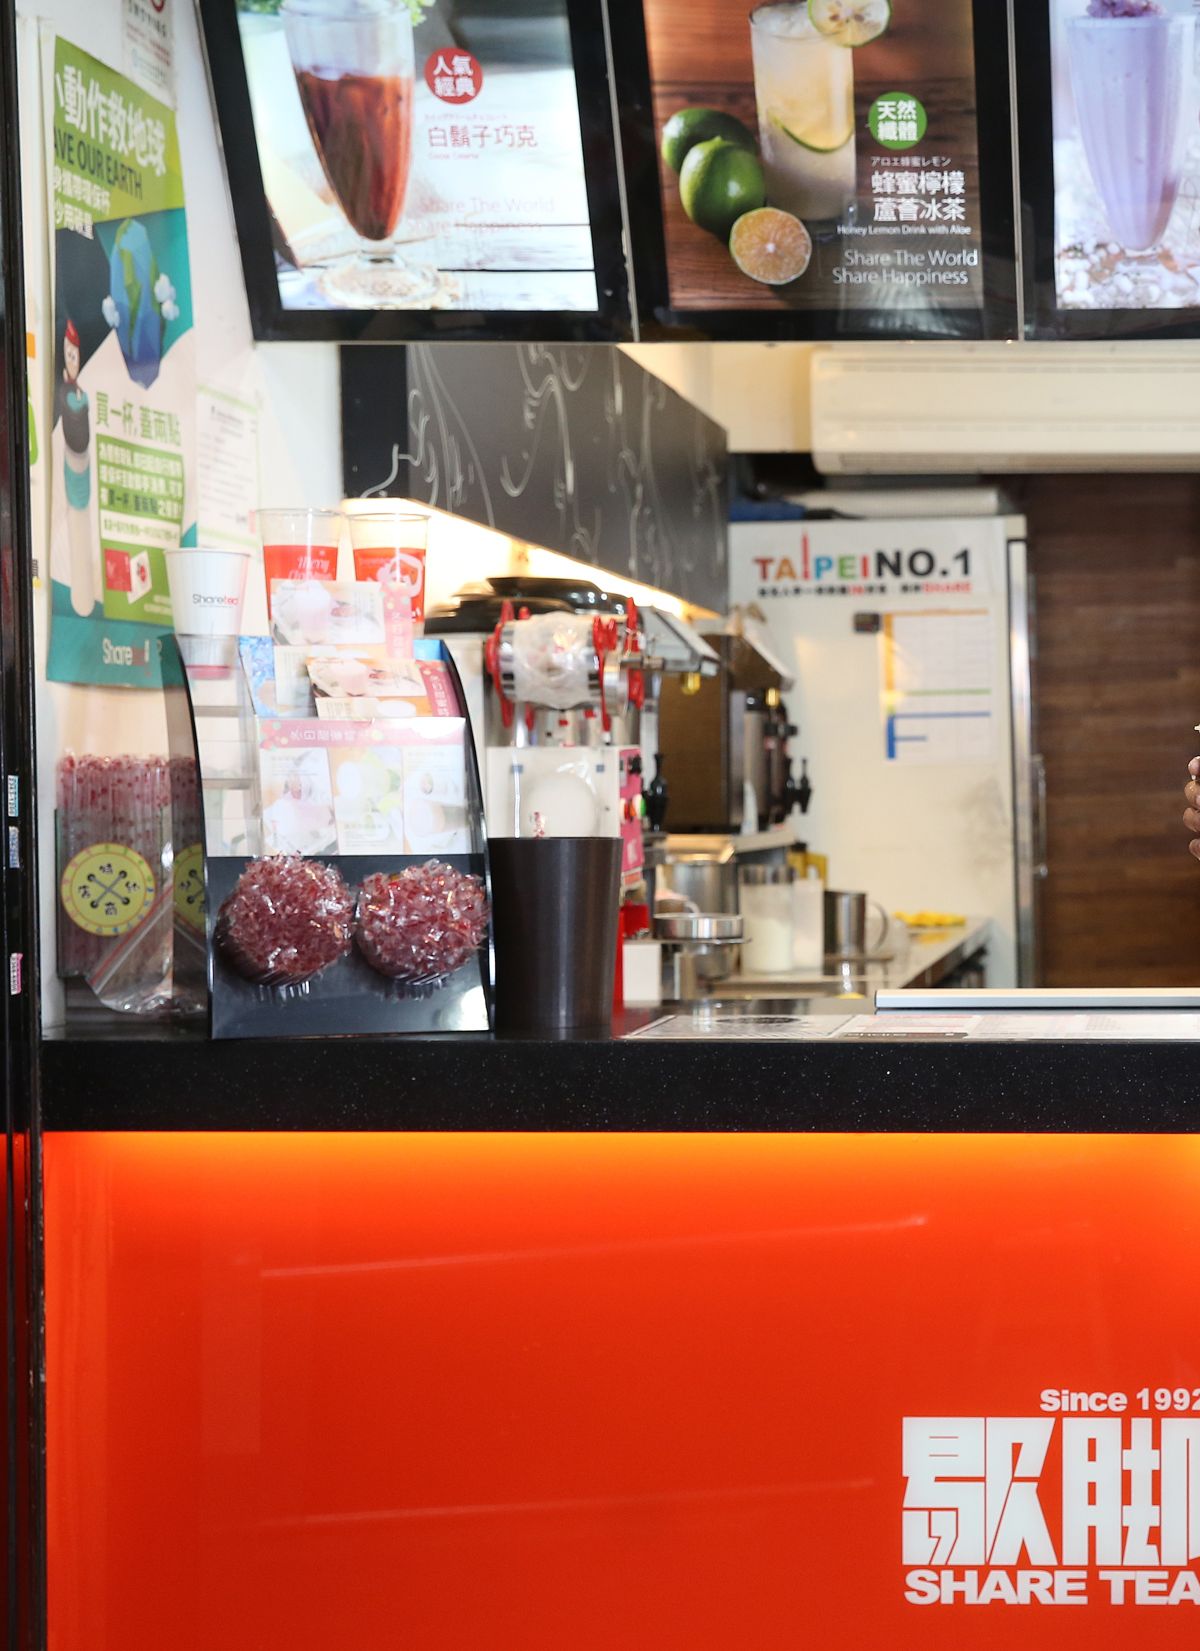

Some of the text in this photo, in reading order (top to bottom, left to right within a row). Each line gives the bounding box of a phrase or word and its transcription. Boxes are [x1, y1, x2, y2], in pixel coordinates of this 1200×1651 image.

[433, 55, 473, 76] 人氣
[55, 64, 166, 177] 動作救地球
[877, 100, 917, 120] 天然
[877, 121, 918, 142] 纖體
[871, 170, 965, 195] 蜂蜜檸檬
[873, 197, 966, 221] 蘆薈冰茶
[837, 225, 972, 237] Honey Lemon Drink with Aloe
[844, 249, 978, 266] Share The World
[832, 269, 968, 287] Share Happiness
[754, 532, 971, 581] TAIPEI NO.1
[1040, 1388, 1127, 1412] Since
[904, 1569, 1088, 1606] SHARE
